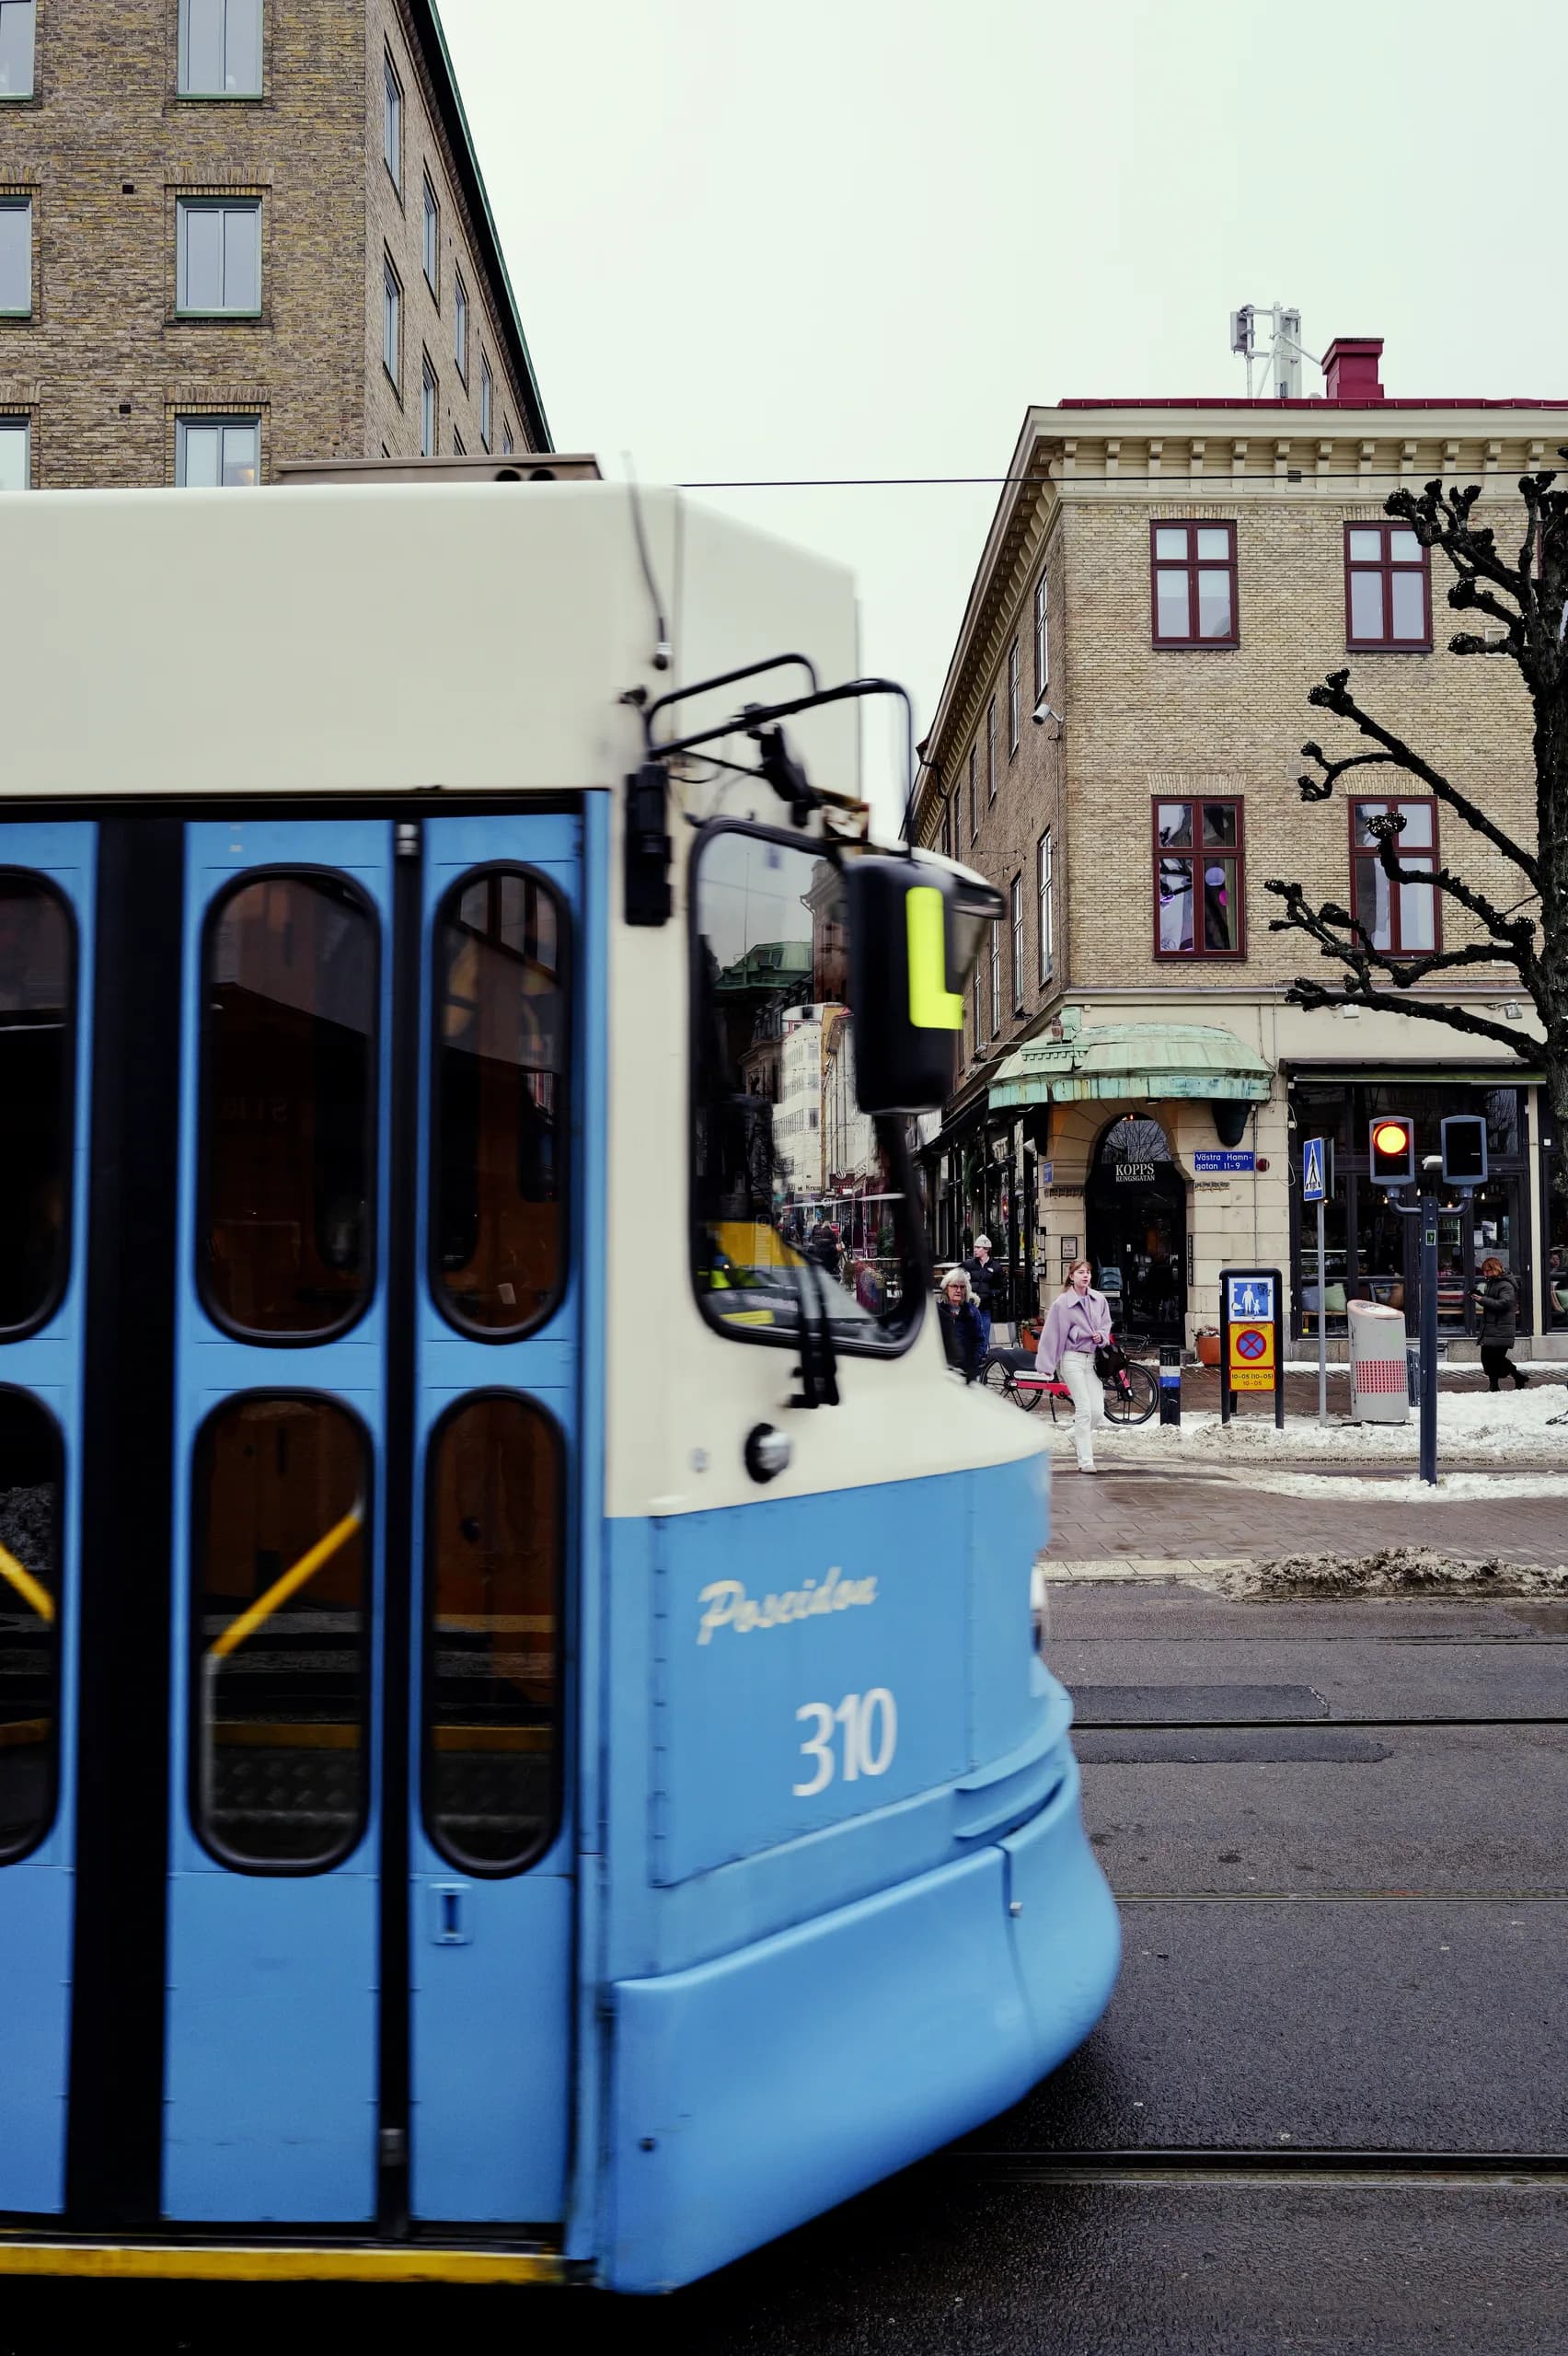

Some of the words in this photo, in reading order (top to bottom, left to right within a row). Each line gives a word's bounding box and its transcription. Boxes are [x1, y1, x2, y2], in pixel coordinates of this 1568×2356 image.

[1195, 1153, 1221, 1161] Västra
[1227, 1153, 1252, 1161] Hamn-
[1115, 1163, 1155, 1176] KOPPS
[1195, 1163, 1218, 1172] gatan
[1115, 1174, 1156, 1183] KUNGSGATAN
[697, 1566, 878, 1645] Poseidon
[792, 1688, 897, 1796] 310
